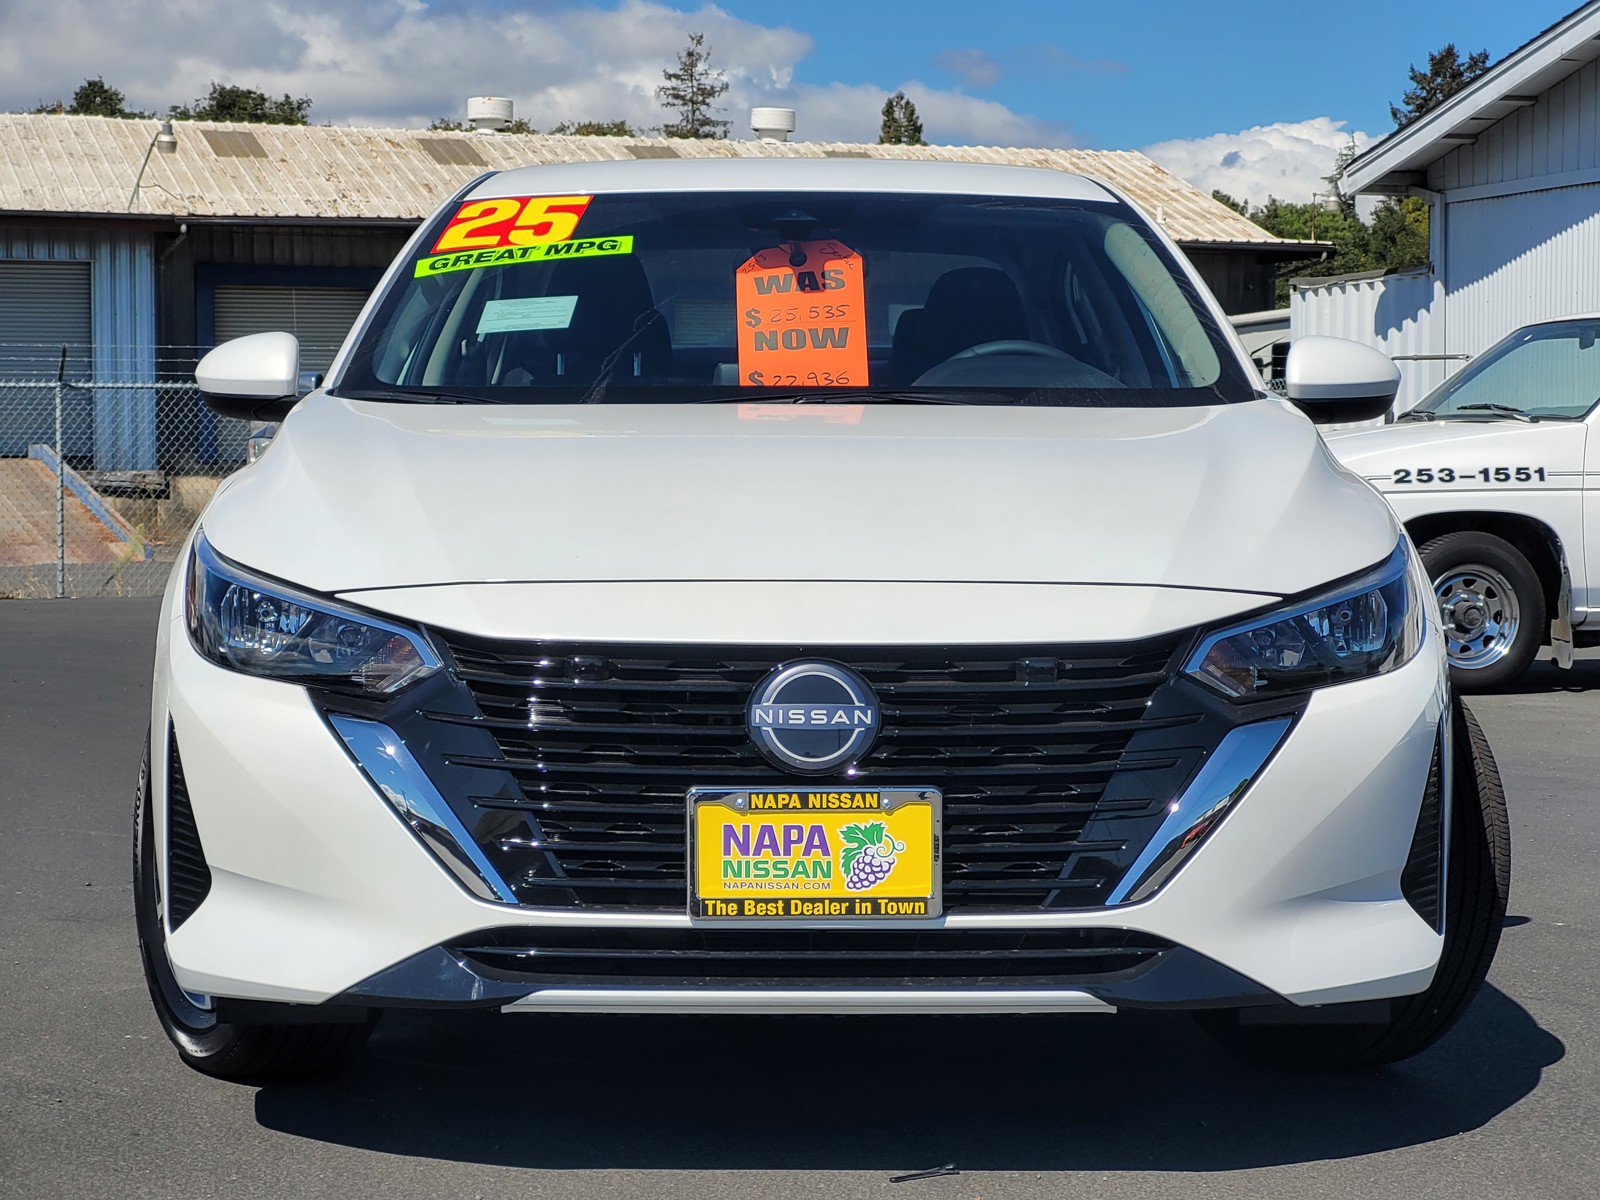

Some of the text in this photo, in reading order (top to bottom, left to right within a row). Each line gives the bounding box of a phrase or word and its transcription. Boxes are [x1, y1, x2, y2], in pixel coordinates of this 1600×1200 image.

[435, 195, 590, 250] 25
[429, 239, 623, 271] GREAT MPG
[753, 268, 846, 295] WAS
[754, 326, 850, 351] NOW
[1393, 467, 1546, 484] 253-1551
[755, 708, 872, 725] NISSAN
[751, 793, 878, 809] NAPA NISSAN
[722, 824, 832, 857] NAPA
[722, 860, 832, 879] NISSAN
[723, 881, 831, 890] NAPANISSAN.COM
[704, 899, 925, 915] The Best Dealer in Town
